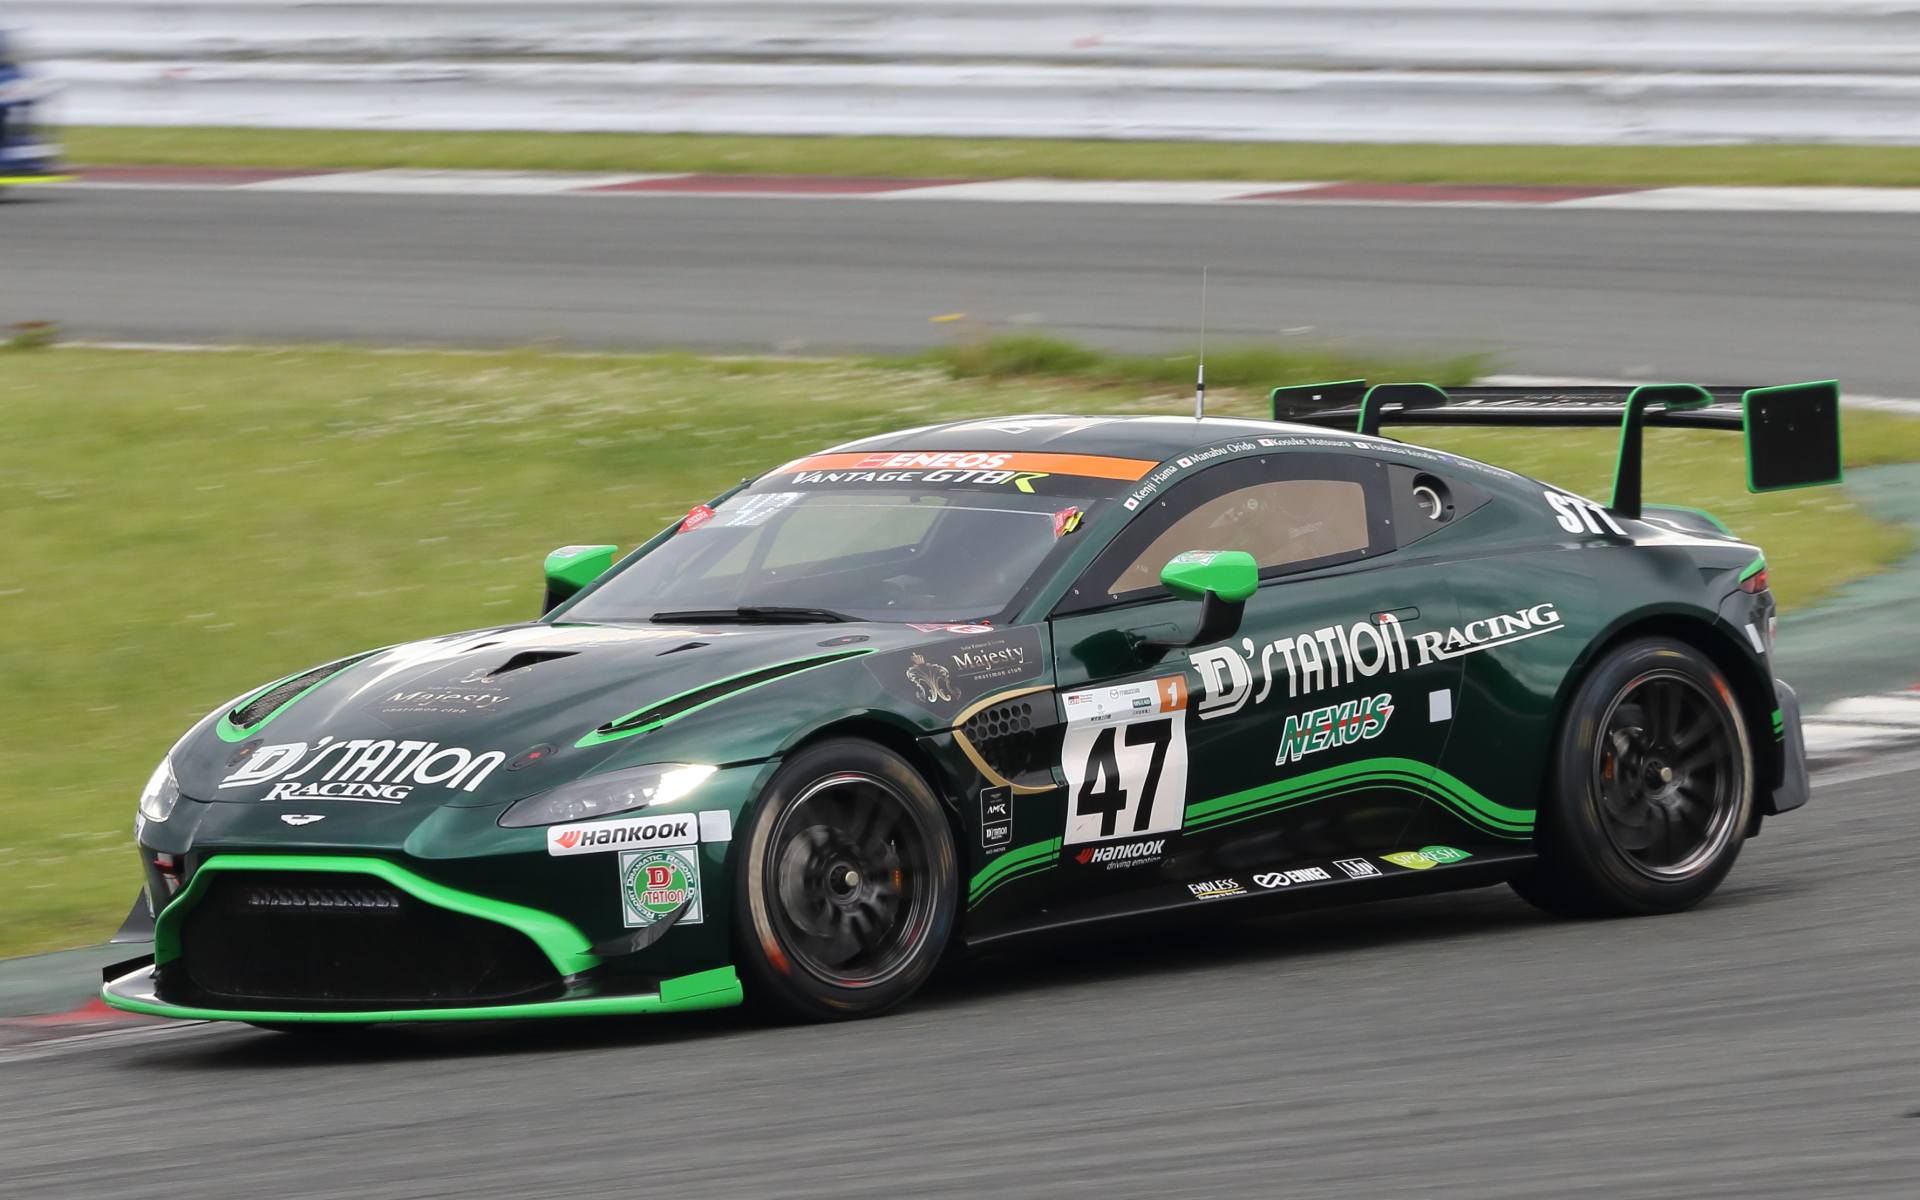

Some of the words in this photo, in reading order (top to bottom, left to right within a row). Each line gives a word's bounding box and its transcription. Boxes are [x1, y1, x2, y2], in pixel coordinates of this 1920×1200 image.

[1272, 437, 1308, 447] Kosuke
[1306, 438, 1352, 448] Matsuura
[882, 453, 1012, 469] ENEOS
[1189, 447, 1228, 464] Manabu
[1227, 441, 1257, 454] Orido
[791, 471, 923, 485] VANTAGE
[1132, 480, 1157, 502] Kenji
[1150, 465, 1178, 485] Hama
[951, 646, 1024, 671] Majesty
[1189, 612, 1410, 720] D'STATION
[1412, 603, 1562, 667] RACING
[1007, 667, 1022, 675] club
[384, 690, 511, 708] Majesty
[1167, 681, 1178, 707] 1
[1275, 694, 1394, 766] NEXUS
[218, 736, 506, 792] D'STATION
[1075, 718, 1173, 838] 47
[260, 782, 413, 801] RACING
[627, 854, 663, 887] DRAMATIC
[666, 854, 694, 884] RESORT
[1107, 859, 1131, 871] driving
[1290, 866, 1332, 883] ENKEI
[1187, 878, 1239, 895] ENDLESS
[640, 889, 685, 905] STATION
